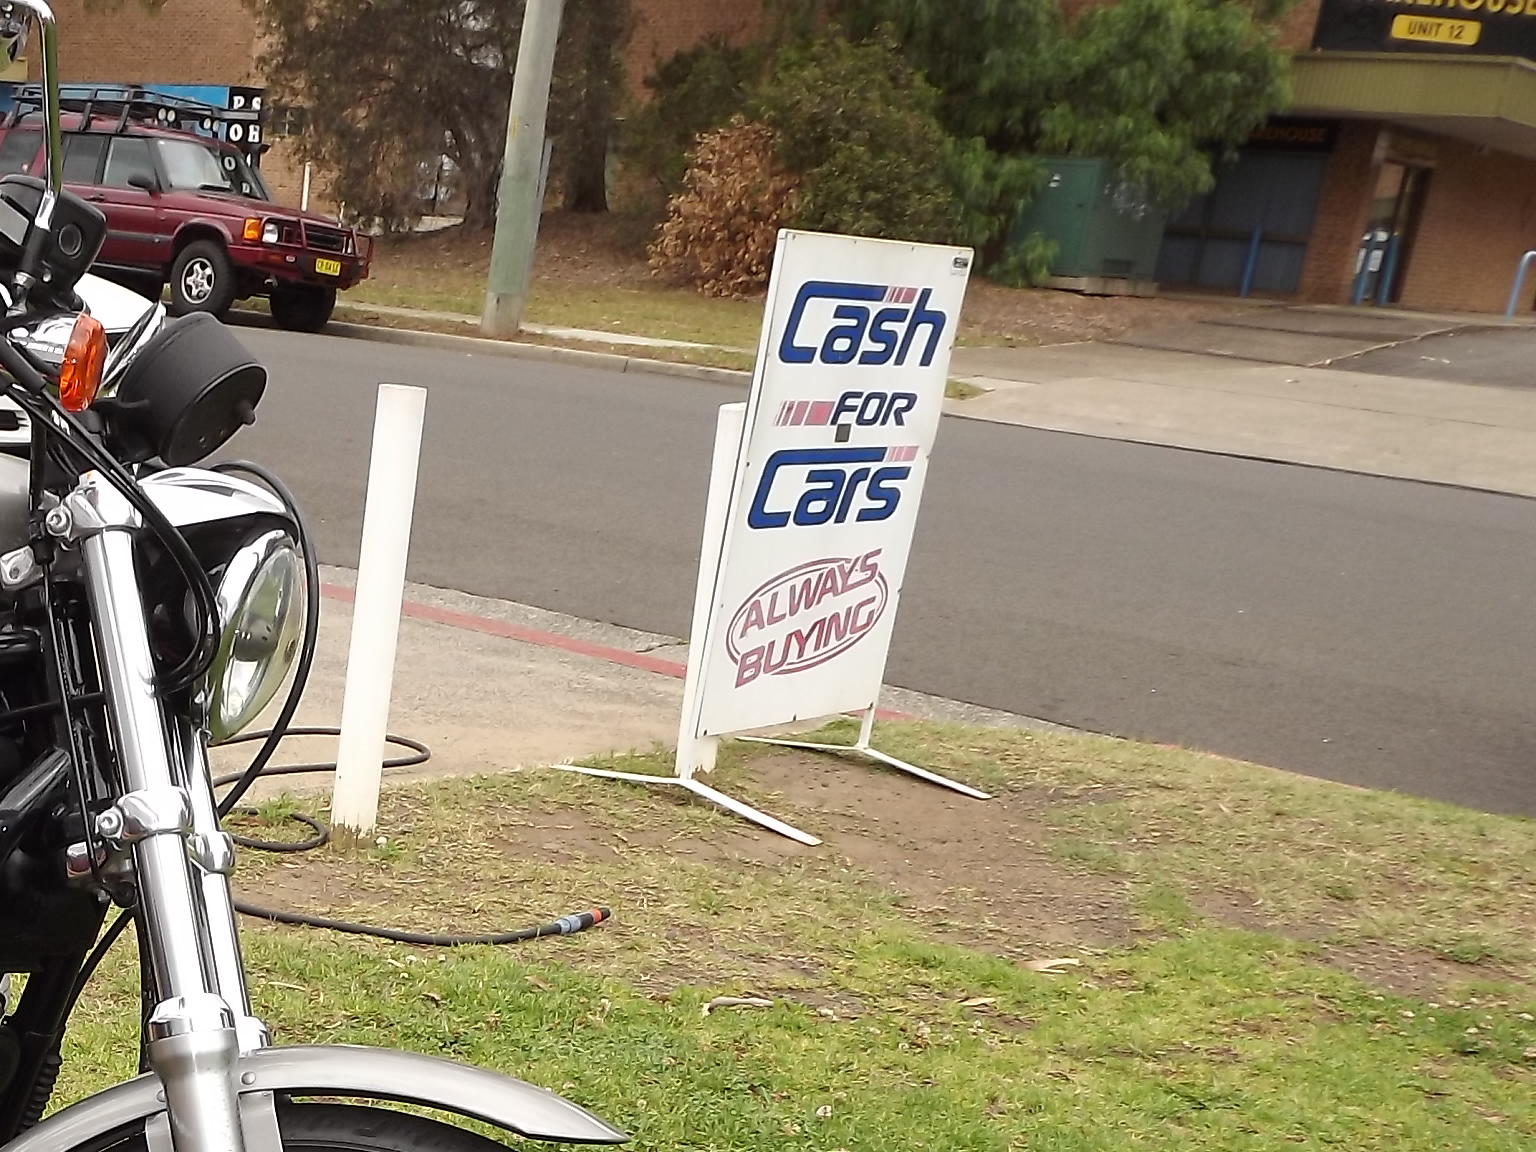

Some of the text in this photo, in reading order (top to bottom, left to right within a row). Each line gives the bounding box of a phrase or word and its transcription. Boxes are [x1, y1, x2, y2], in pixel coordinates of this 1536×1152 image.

[1408, 20, 1464, 39] UNIT 12
[778, 280, 947, 368] Cash
[830, 391, 918, 428] FOR
[747, 447, 913, 531] Cars
[739, 548, 882, 640] ALWAYS
[734, 596, 877, 689] BUYING
